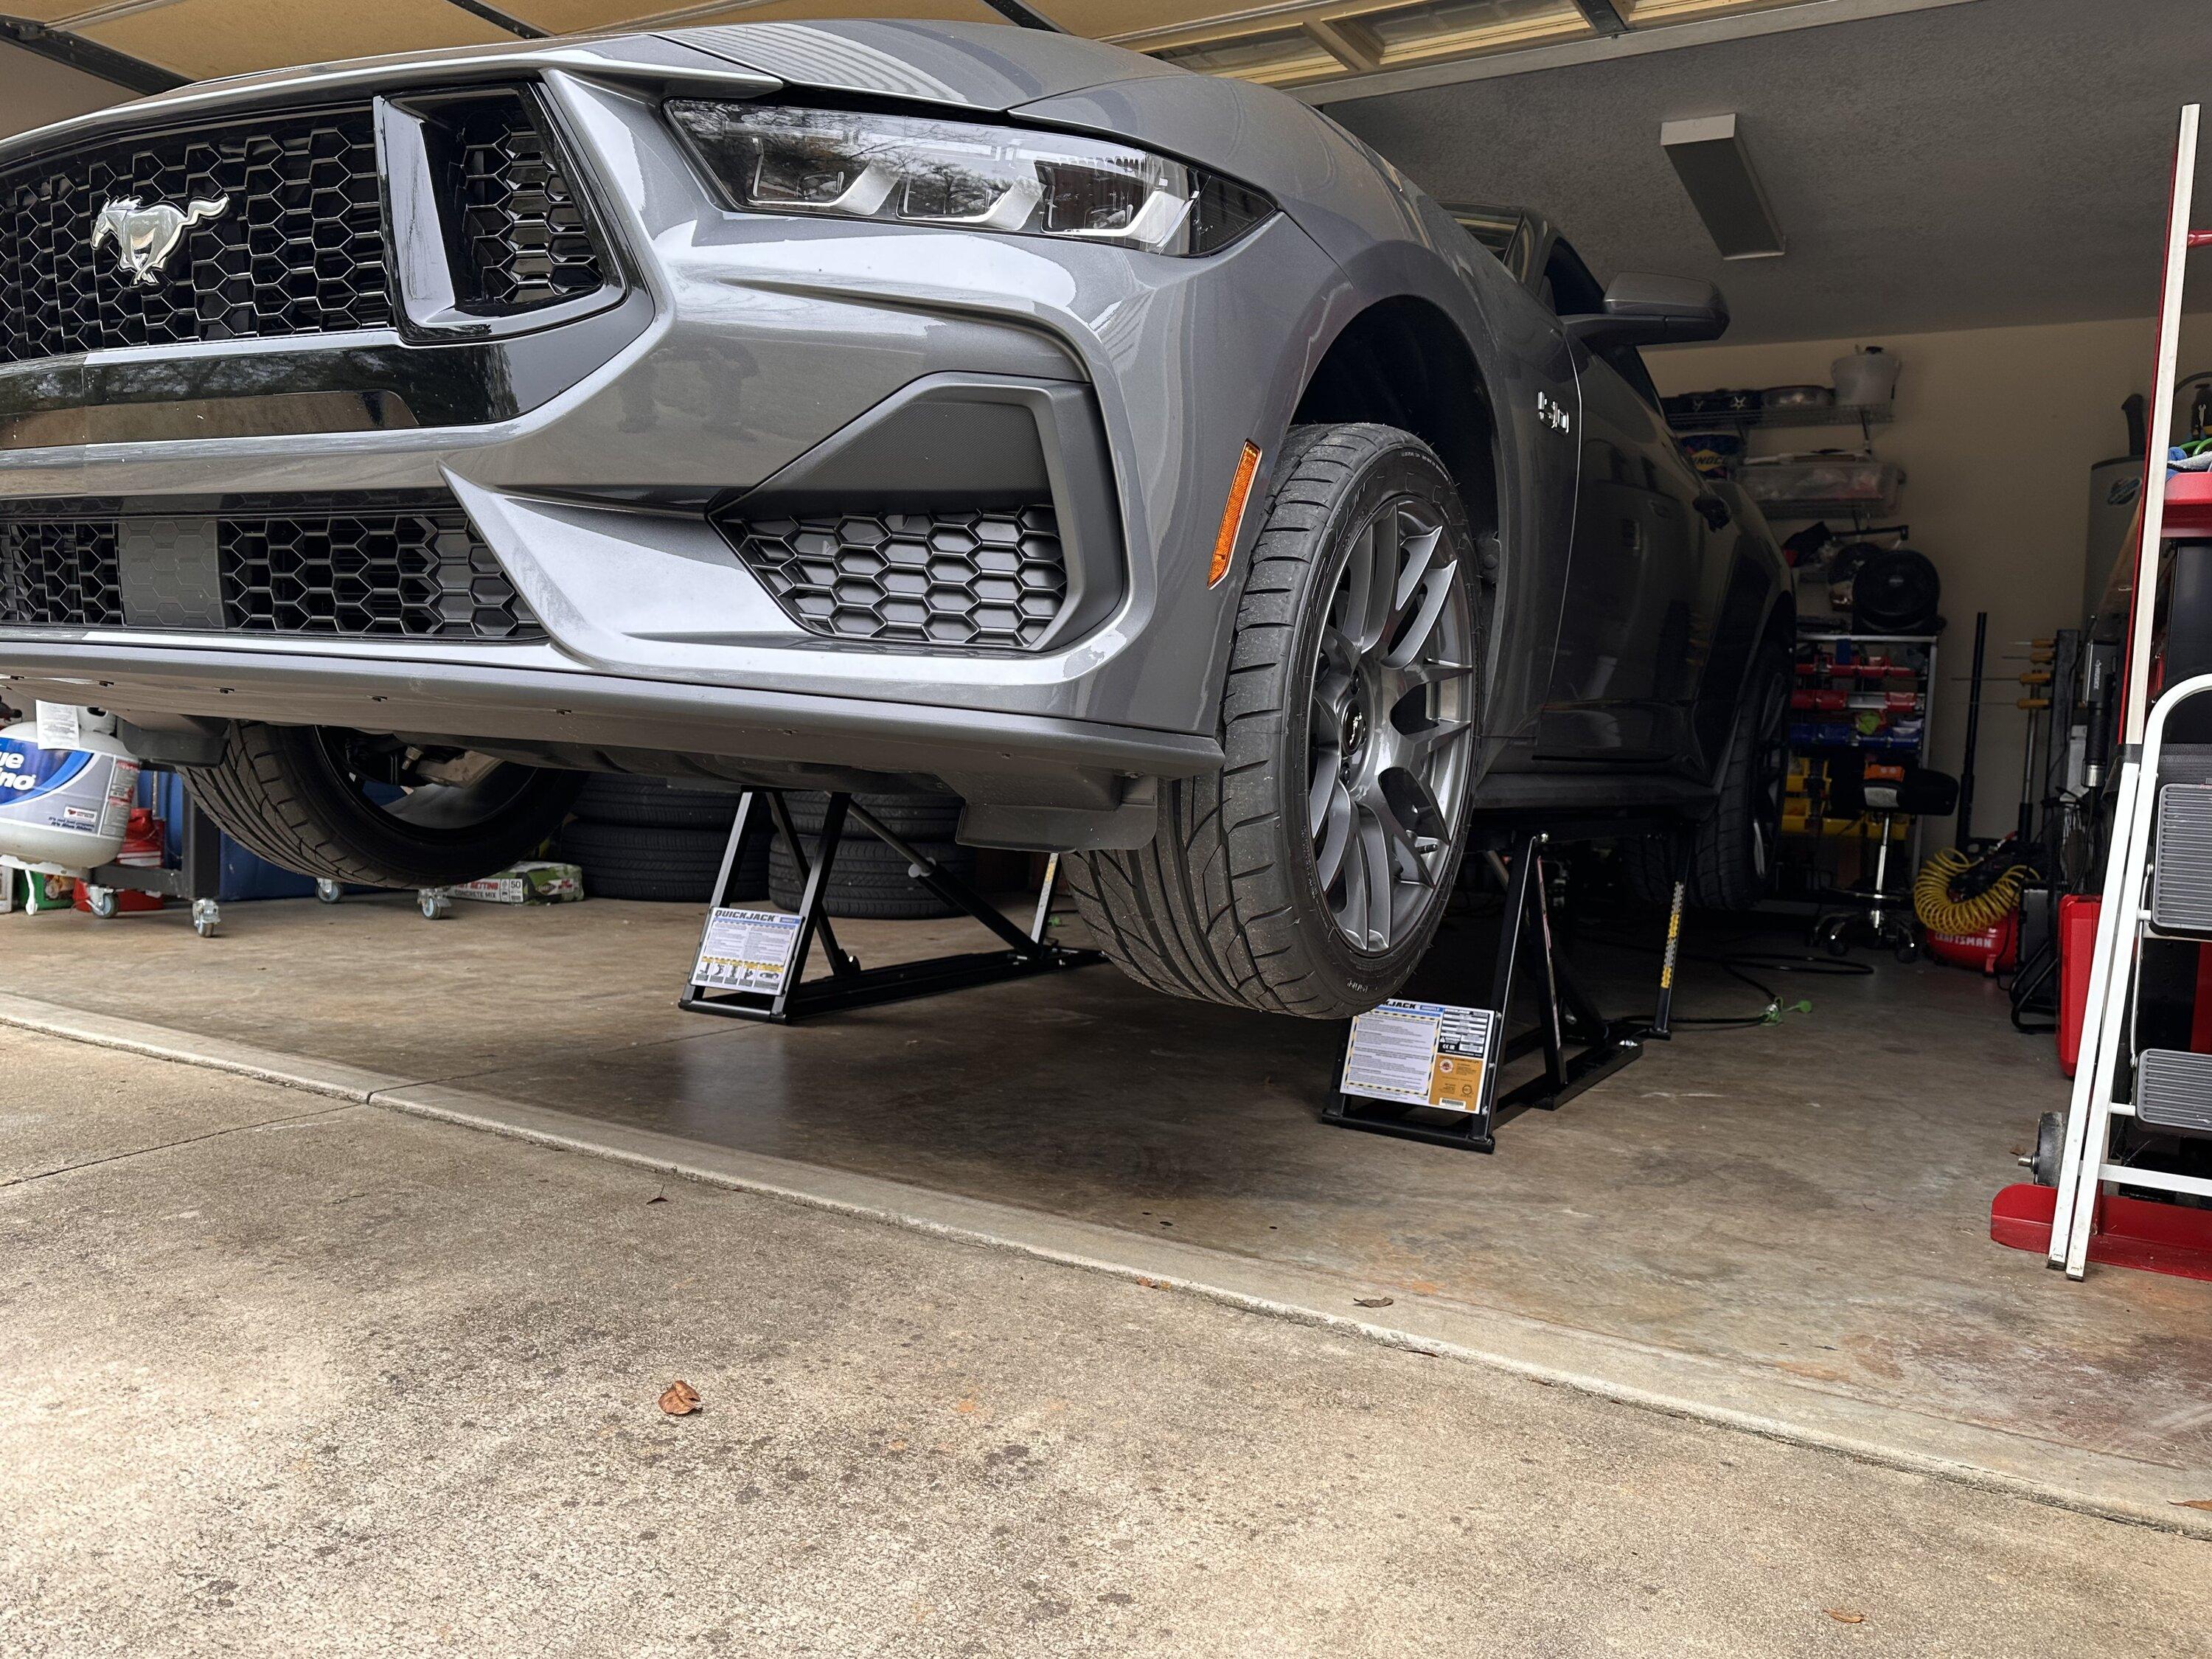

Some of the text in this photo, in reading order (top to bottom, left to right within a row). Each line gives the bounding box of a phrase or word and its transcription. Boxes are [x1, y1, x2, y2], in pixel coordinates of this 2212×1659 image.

[510, 880, 521, 888] 50
[454, 889, 484, 898] CONCRETE
[714, 910, 776, 922] QUICKJACK
